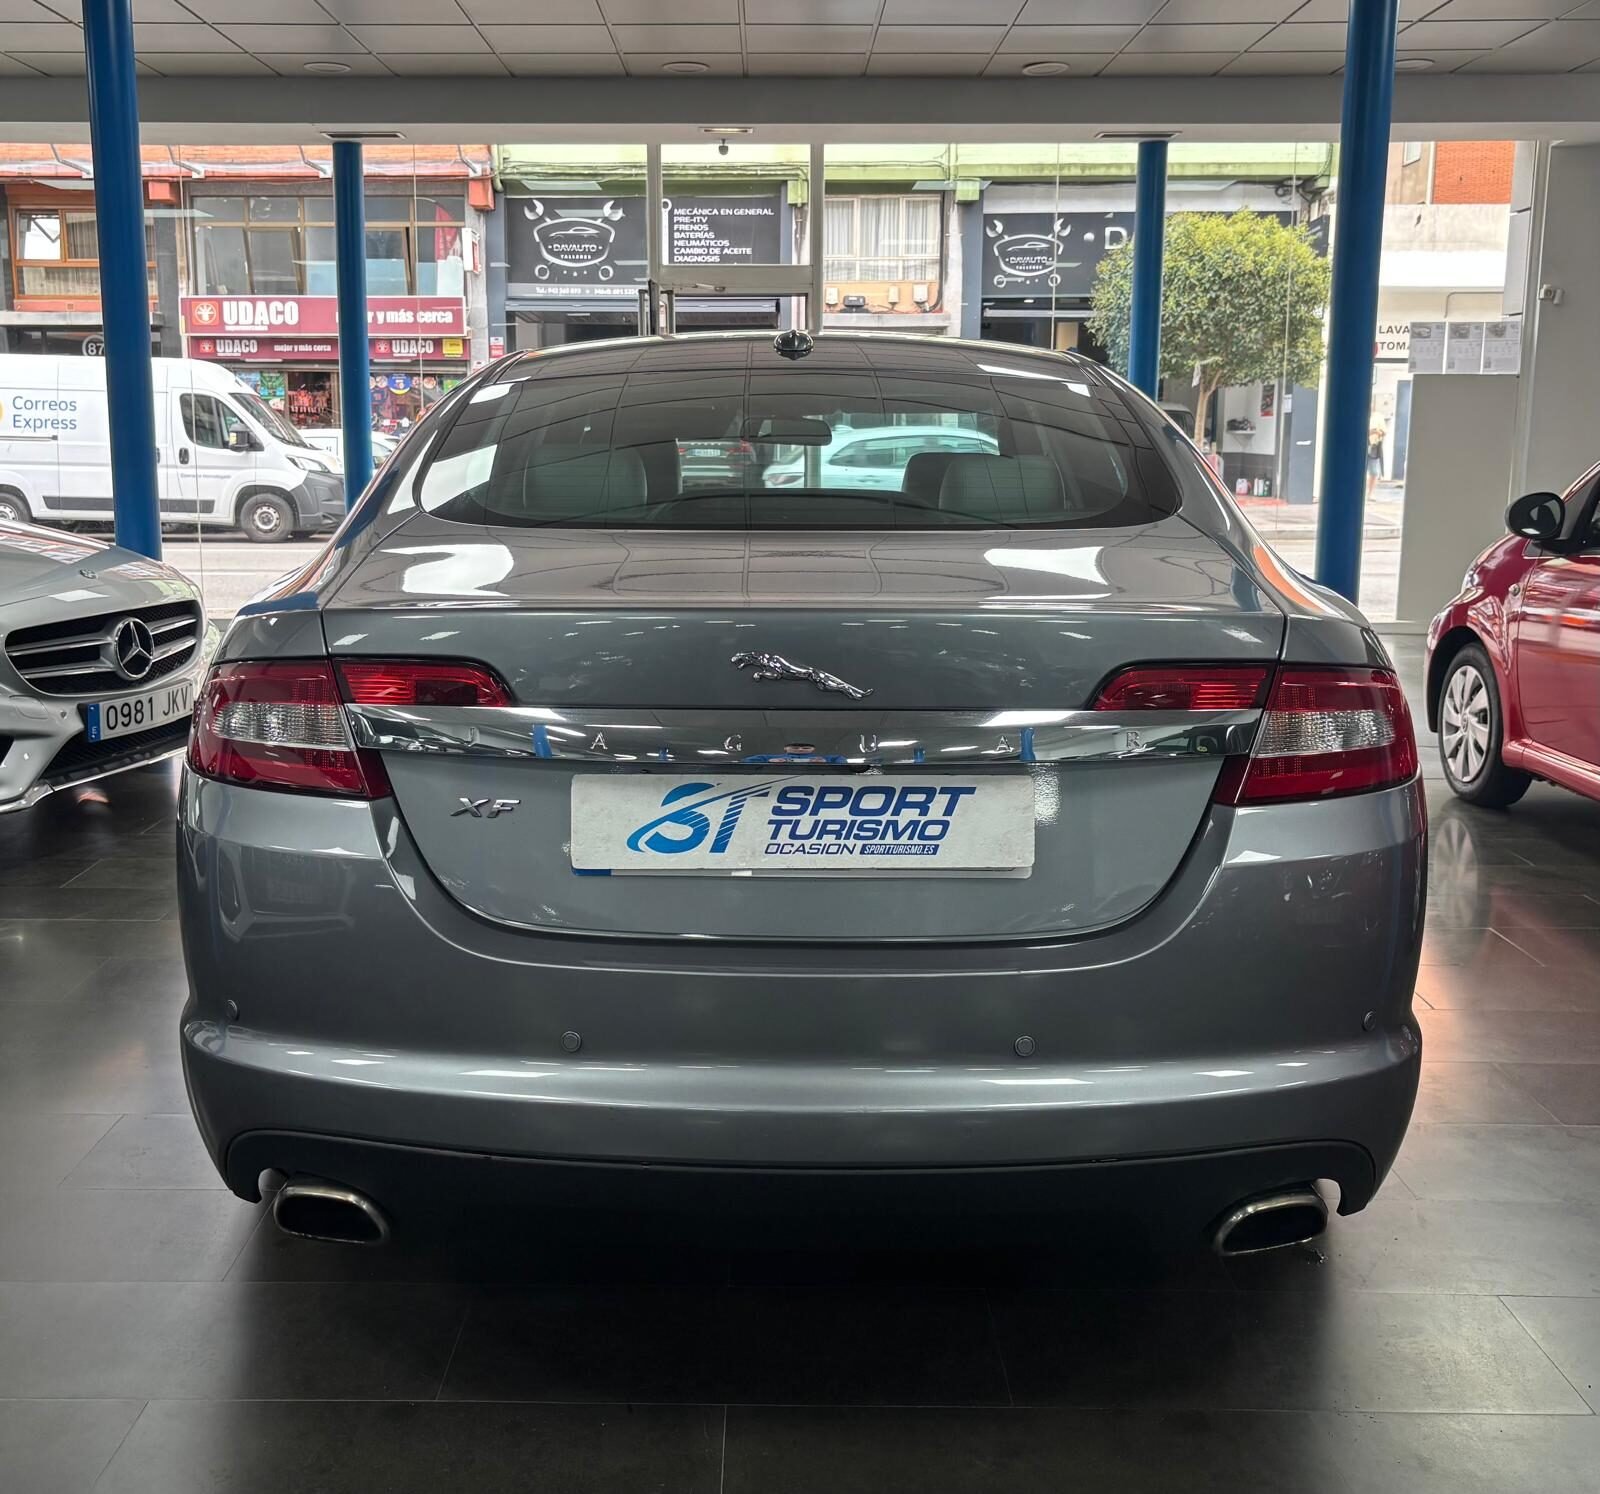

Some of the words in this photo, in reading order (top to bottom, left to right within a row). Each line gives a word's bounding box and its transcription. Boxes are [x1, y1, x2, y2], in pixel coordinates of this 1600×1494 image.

[673, 231, 715, 239] BATERÍAS
[553, 243, 598, 252] DAVAUTO
[673, 239, 730, 247] NEUMÁTICOS
[673, 255, 720, 263] DIAGNOSIS
[222, 300, 300, 325] UDACO
[376, 311, 384, 324] y
[386, 308, 414, 323] más
[416, 310, 453, 324] cerca
[216, 339, 258, 353] UDACO
[273, 344, 292, 352] mejor
[298, 344, 312, 352] más
[312, 344, 332, 352] cerca
[391, 339, 434, 354] UDACO
[1379, 341, 1410, 350] TOM
[12, 396, 78, 412] Correos
[12, 414, 78, 433] Express
[106, 697, 154, 731] 0981
[163, 686, 189, 716] JKV
[450, 797, 522, 819] XF
[770, 785, 978, 817] SPORT
[766, 818, 952, 842] TURISMO
[764, 842, 857, 856] OCASION
[863, 844, 937, 856] SPORTTURISMO.ES
